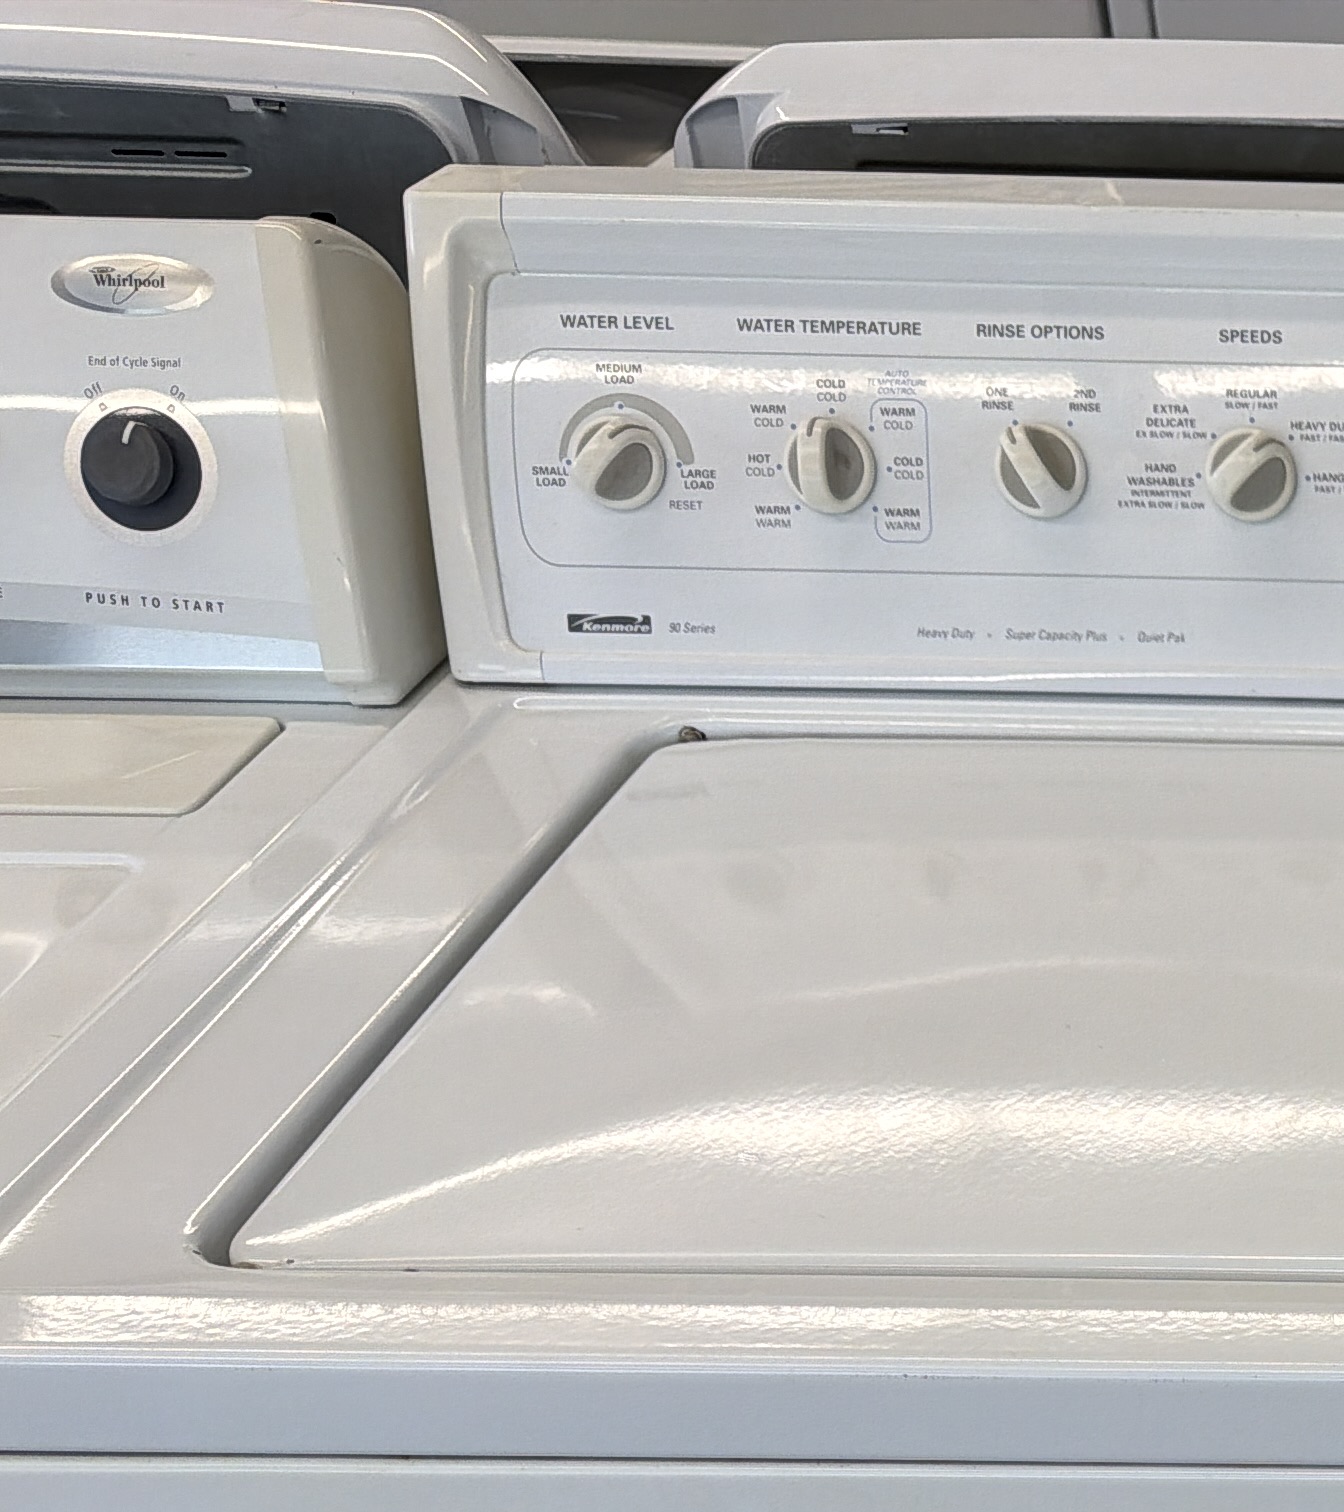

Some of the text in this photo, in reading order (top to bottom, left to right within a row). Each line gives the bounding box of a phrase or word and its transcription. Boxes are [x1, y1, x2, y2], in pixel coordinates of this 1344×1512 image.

[92, 273, 166, 291] Whirlpool
[559, 314, 674, 330] WATER LEVEL
[737, 318, 922, 336] WATER TEMPERATURE
[976, 324, 1105, 340] RINSE OPTIONS
[1219, 329, 1283, 344] SPEEDS
[88, 356, 181, 369] End of Cycle Signal
[596, 363, 642, 373] MEDIUM
[604, 375, 635, 385] LOAD
[816, 379, 846, 389] COLD
[83, 381, 103, 400] Off
[169, 385, 186, 402] On
[986, 386, 1008, 397] ONE
[1073, 389, 1096, 399] 2ND
[1226, 389, 1277, 399] REGULAR
[816, 392, 846, 402] COLD
[750, 404, 786, 414] WARM
[981, 401, 1013, 410] RINSE
[1069, 403, 1101, 413] RINSE
[1153, 404, 1189, 414] EXTRA
[880, 407, 916, 417] WARM
[754, 417, 784, 428] COLD
[883, 420, 914, 430] COLD
[1145, 417, 1196, 428] DELICATE
[1290, 421, 1326, 431] HEAVY
[747, 454, 771, 463] HOT
[893, 457, 923, 466] COLD
[532, 466, 569, 476] SMALL
[745, 467, 775, 477] COLD
[1145, 463, 1176, 473] HAND
[680, 469, 716, 479] LARGE
[894, 470, 924, 480] COLD
[1313, 473, 1344, 482] HANG
[536, 477, 566, 487] LOAD
[684, 480, 715, 490] LOAD
[1127, 476, 1195, 487] WASHABLES
[669, 500, 703, 510] RESET
[755, 505, 791, 515] WARM
[884, 508, 920, 518] WARM
[755, 519, 791, 528] WARM
[885, 521, 921, 531] WARM
[85, 592, 225, 613] PUSH TO START
[582, 622, 716, 634] Kenmore 90 Series
[917, 627, 1185, 643] Heavy Duty Super Capacity Plus Quiet Pak
